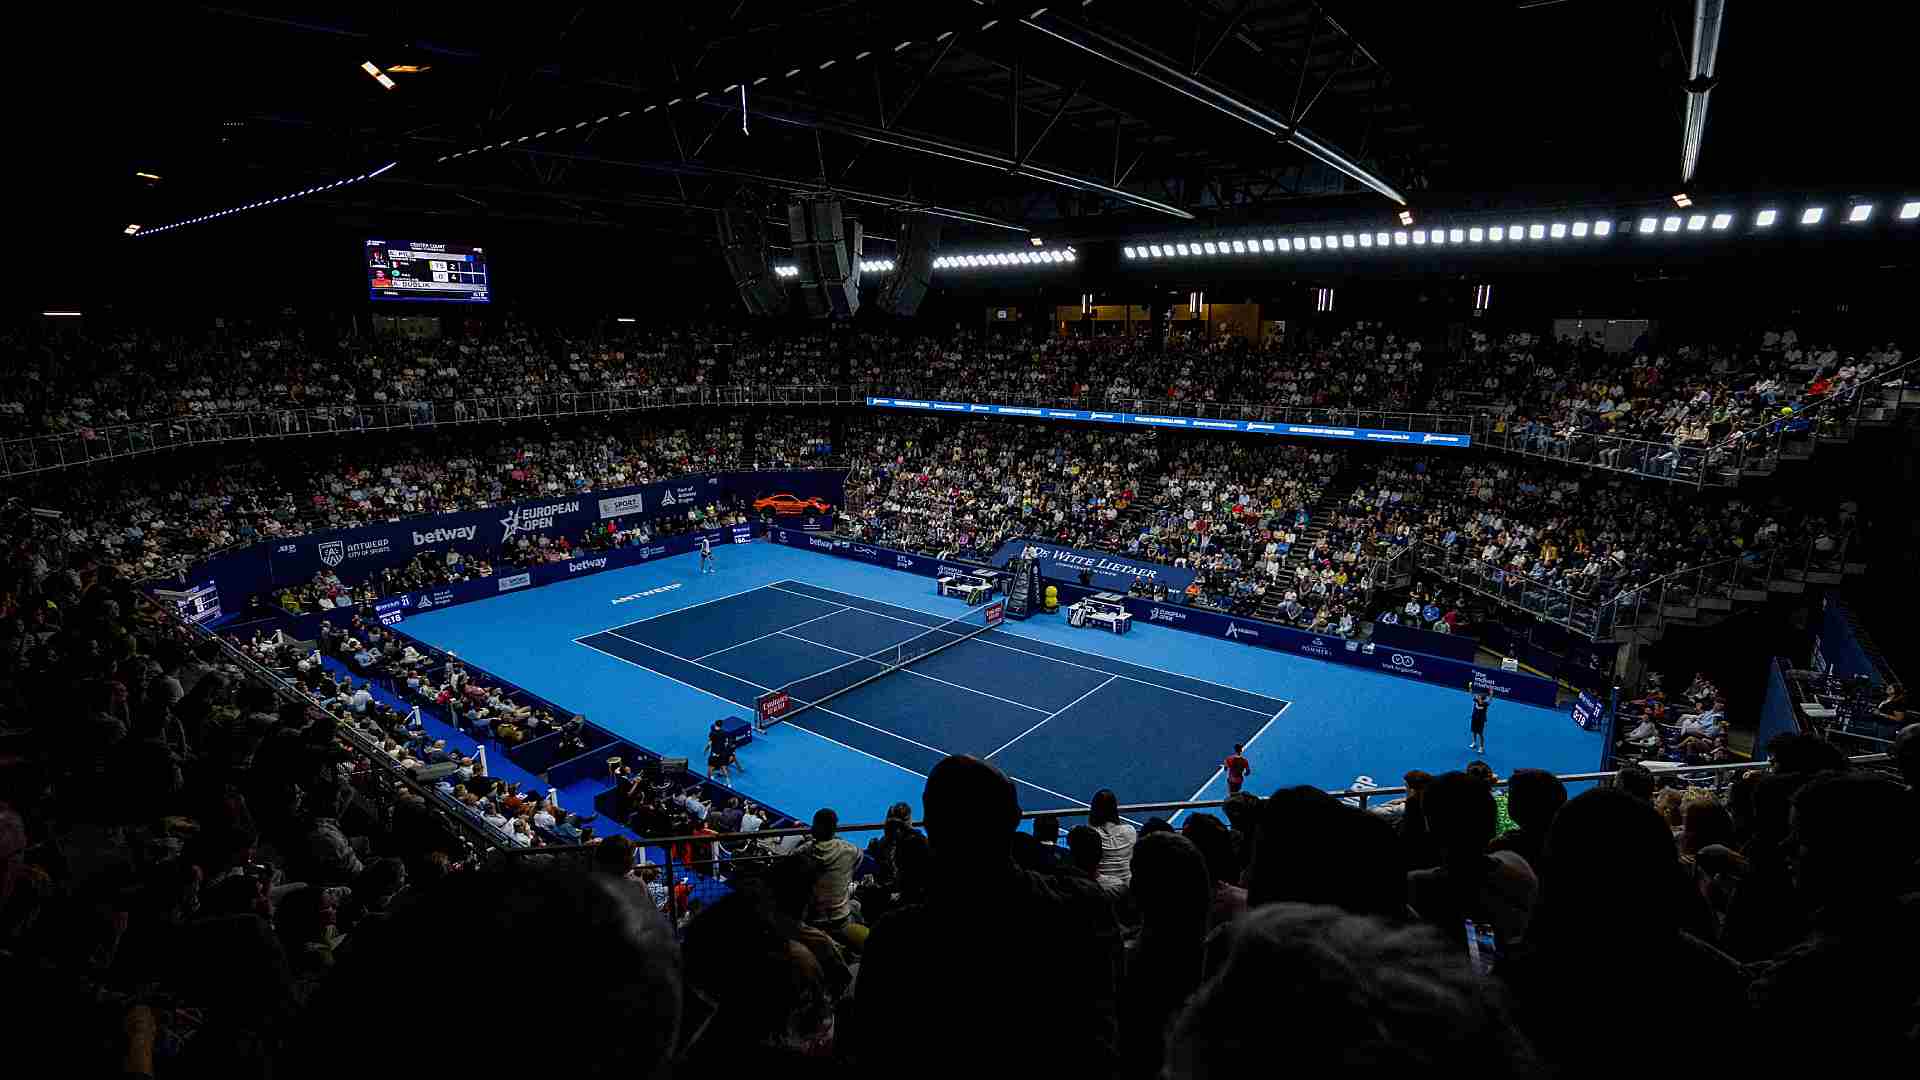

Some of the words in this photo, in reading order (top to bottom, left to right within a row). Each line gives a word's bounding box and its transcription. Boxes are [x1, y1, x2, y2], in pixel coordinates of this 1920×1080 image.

[522, 501, 580, 519] EUROPEAN
[524, 516, 553, 531] OPEN
[412, 525, 477, 546] betway
[809, 536, 832, 551] betway
[569, 557, 607, 573] betway
